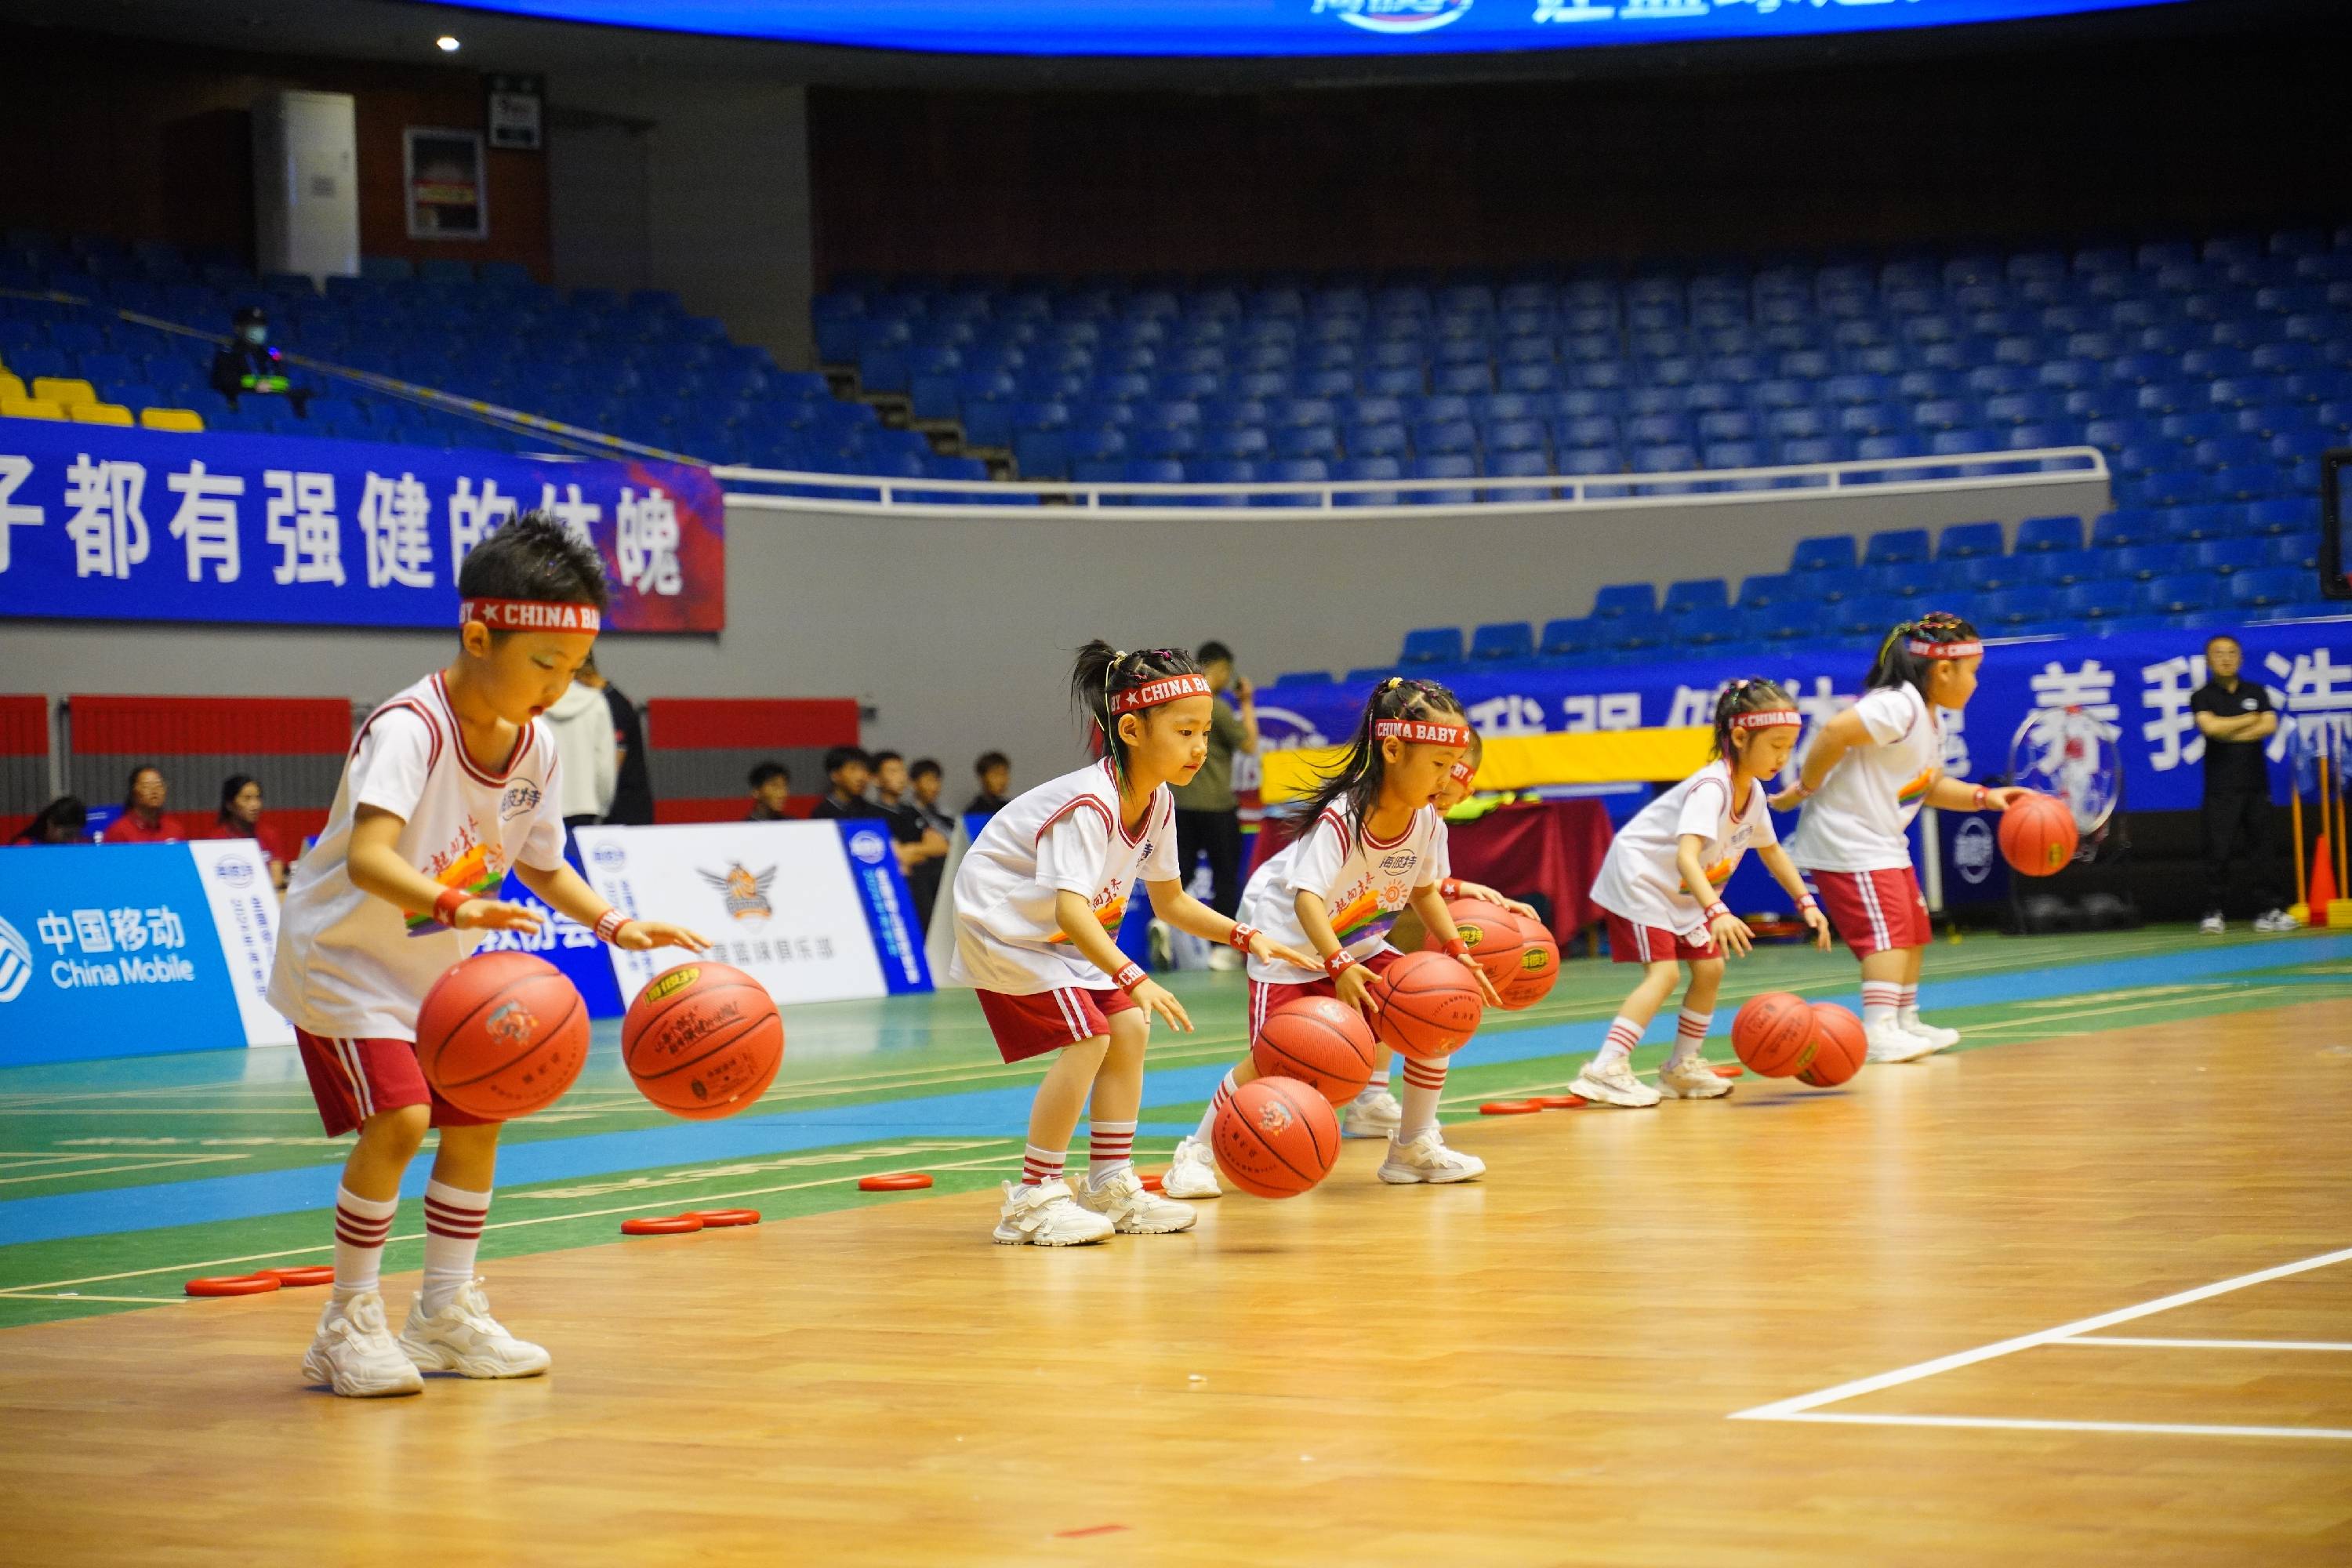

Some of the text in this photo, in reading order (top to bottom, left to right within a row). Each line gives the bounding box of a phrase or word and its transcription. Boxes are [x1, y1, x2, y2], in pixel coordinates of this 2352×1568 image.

[504, 604, 577, 628] CHINA
[1142, 678, 1193, 703] CHINA
[1377, 721, 1457, 743] CHINA BABY
[37, 904, 186, 956] 中国移动
[51, 953, 195, 989] China Mobile
